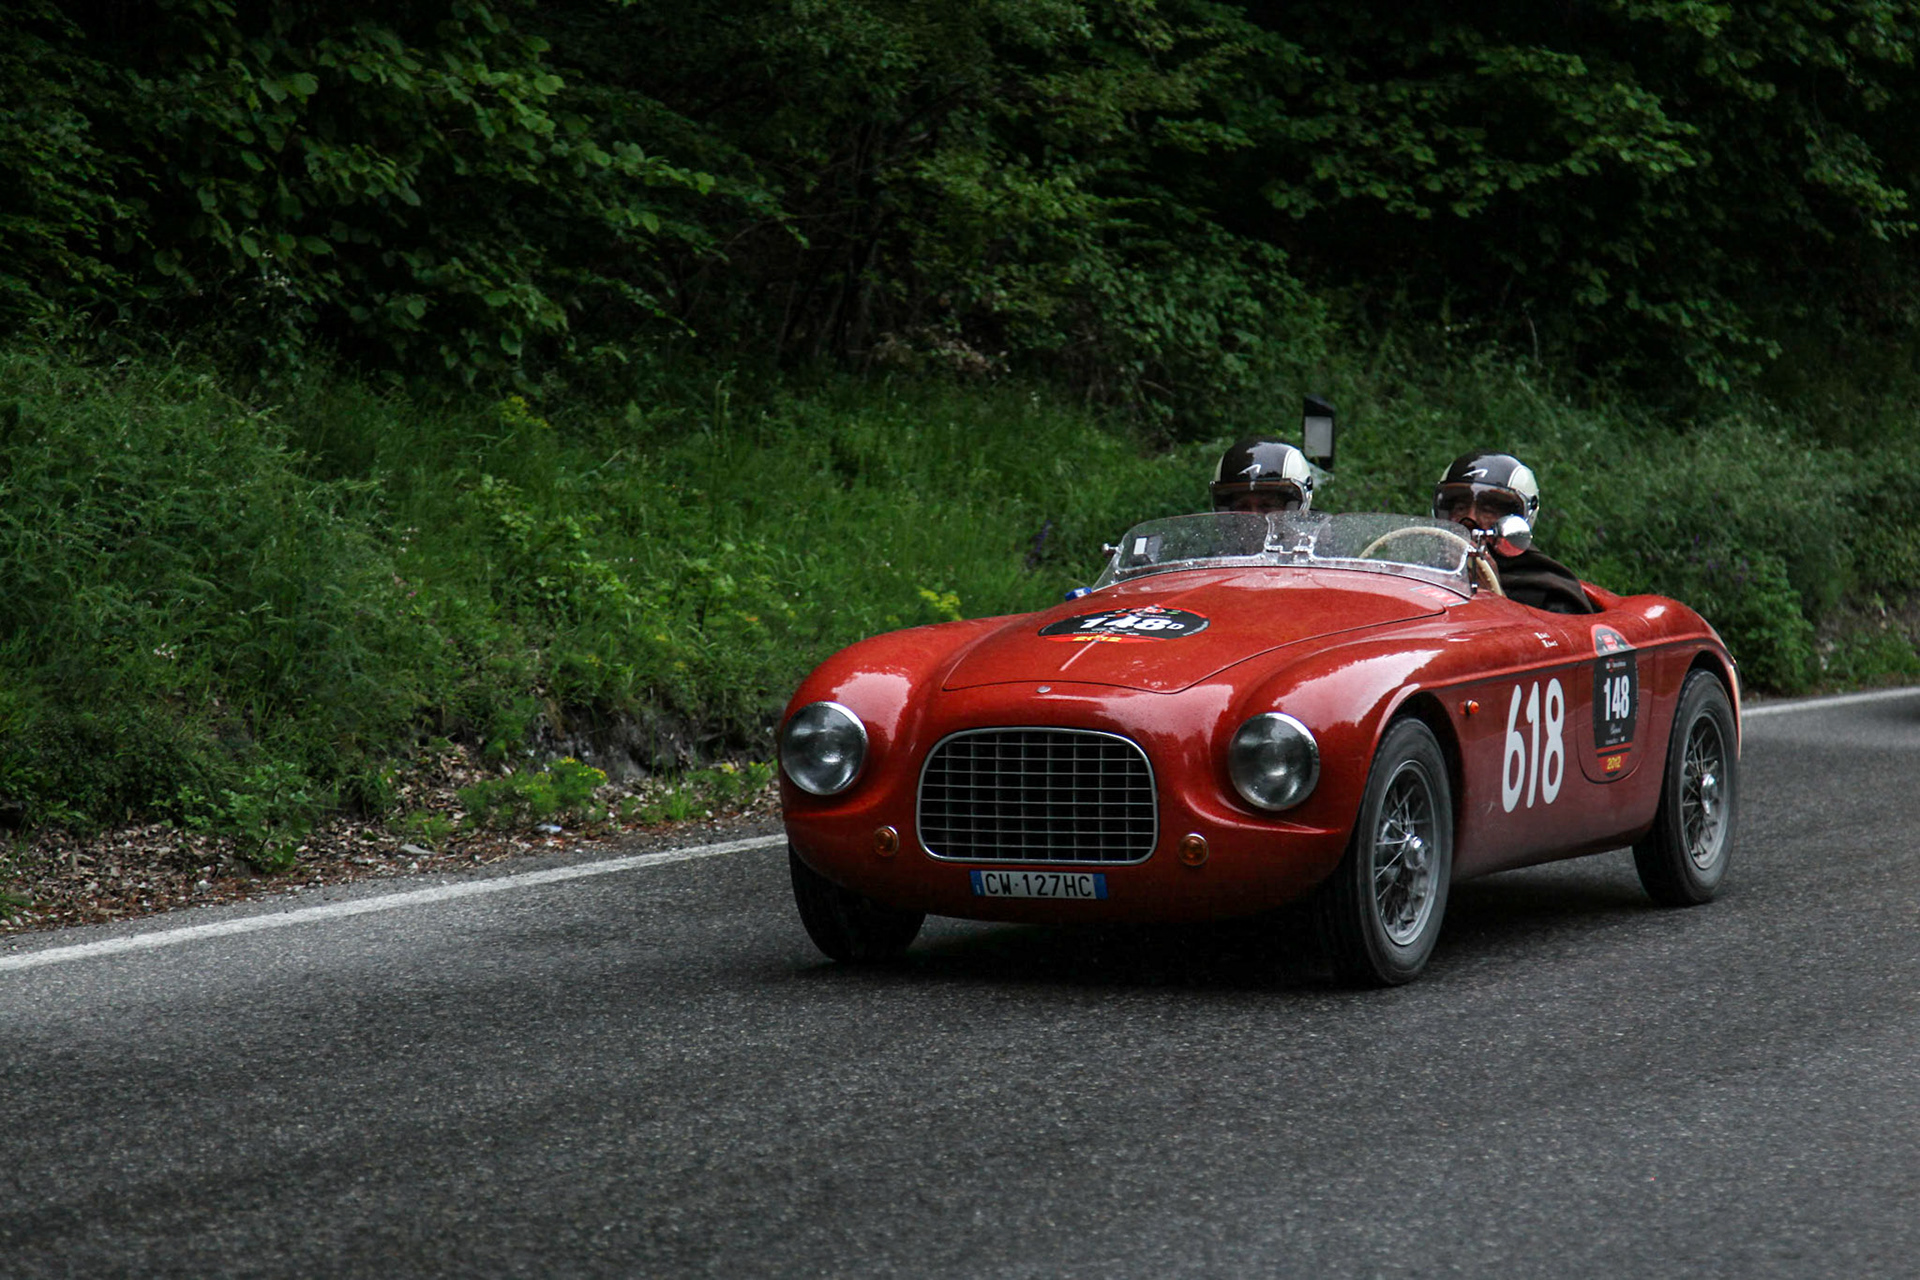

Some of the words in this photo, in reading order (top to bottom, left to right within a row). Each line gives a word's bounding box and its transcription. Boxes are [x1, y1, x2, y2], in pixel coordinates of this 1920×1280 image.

[1603, 675, 1630, 721] 148
[1502, 678, 1565, 813] 618
[1606, 756, 1622, 770] 2012
